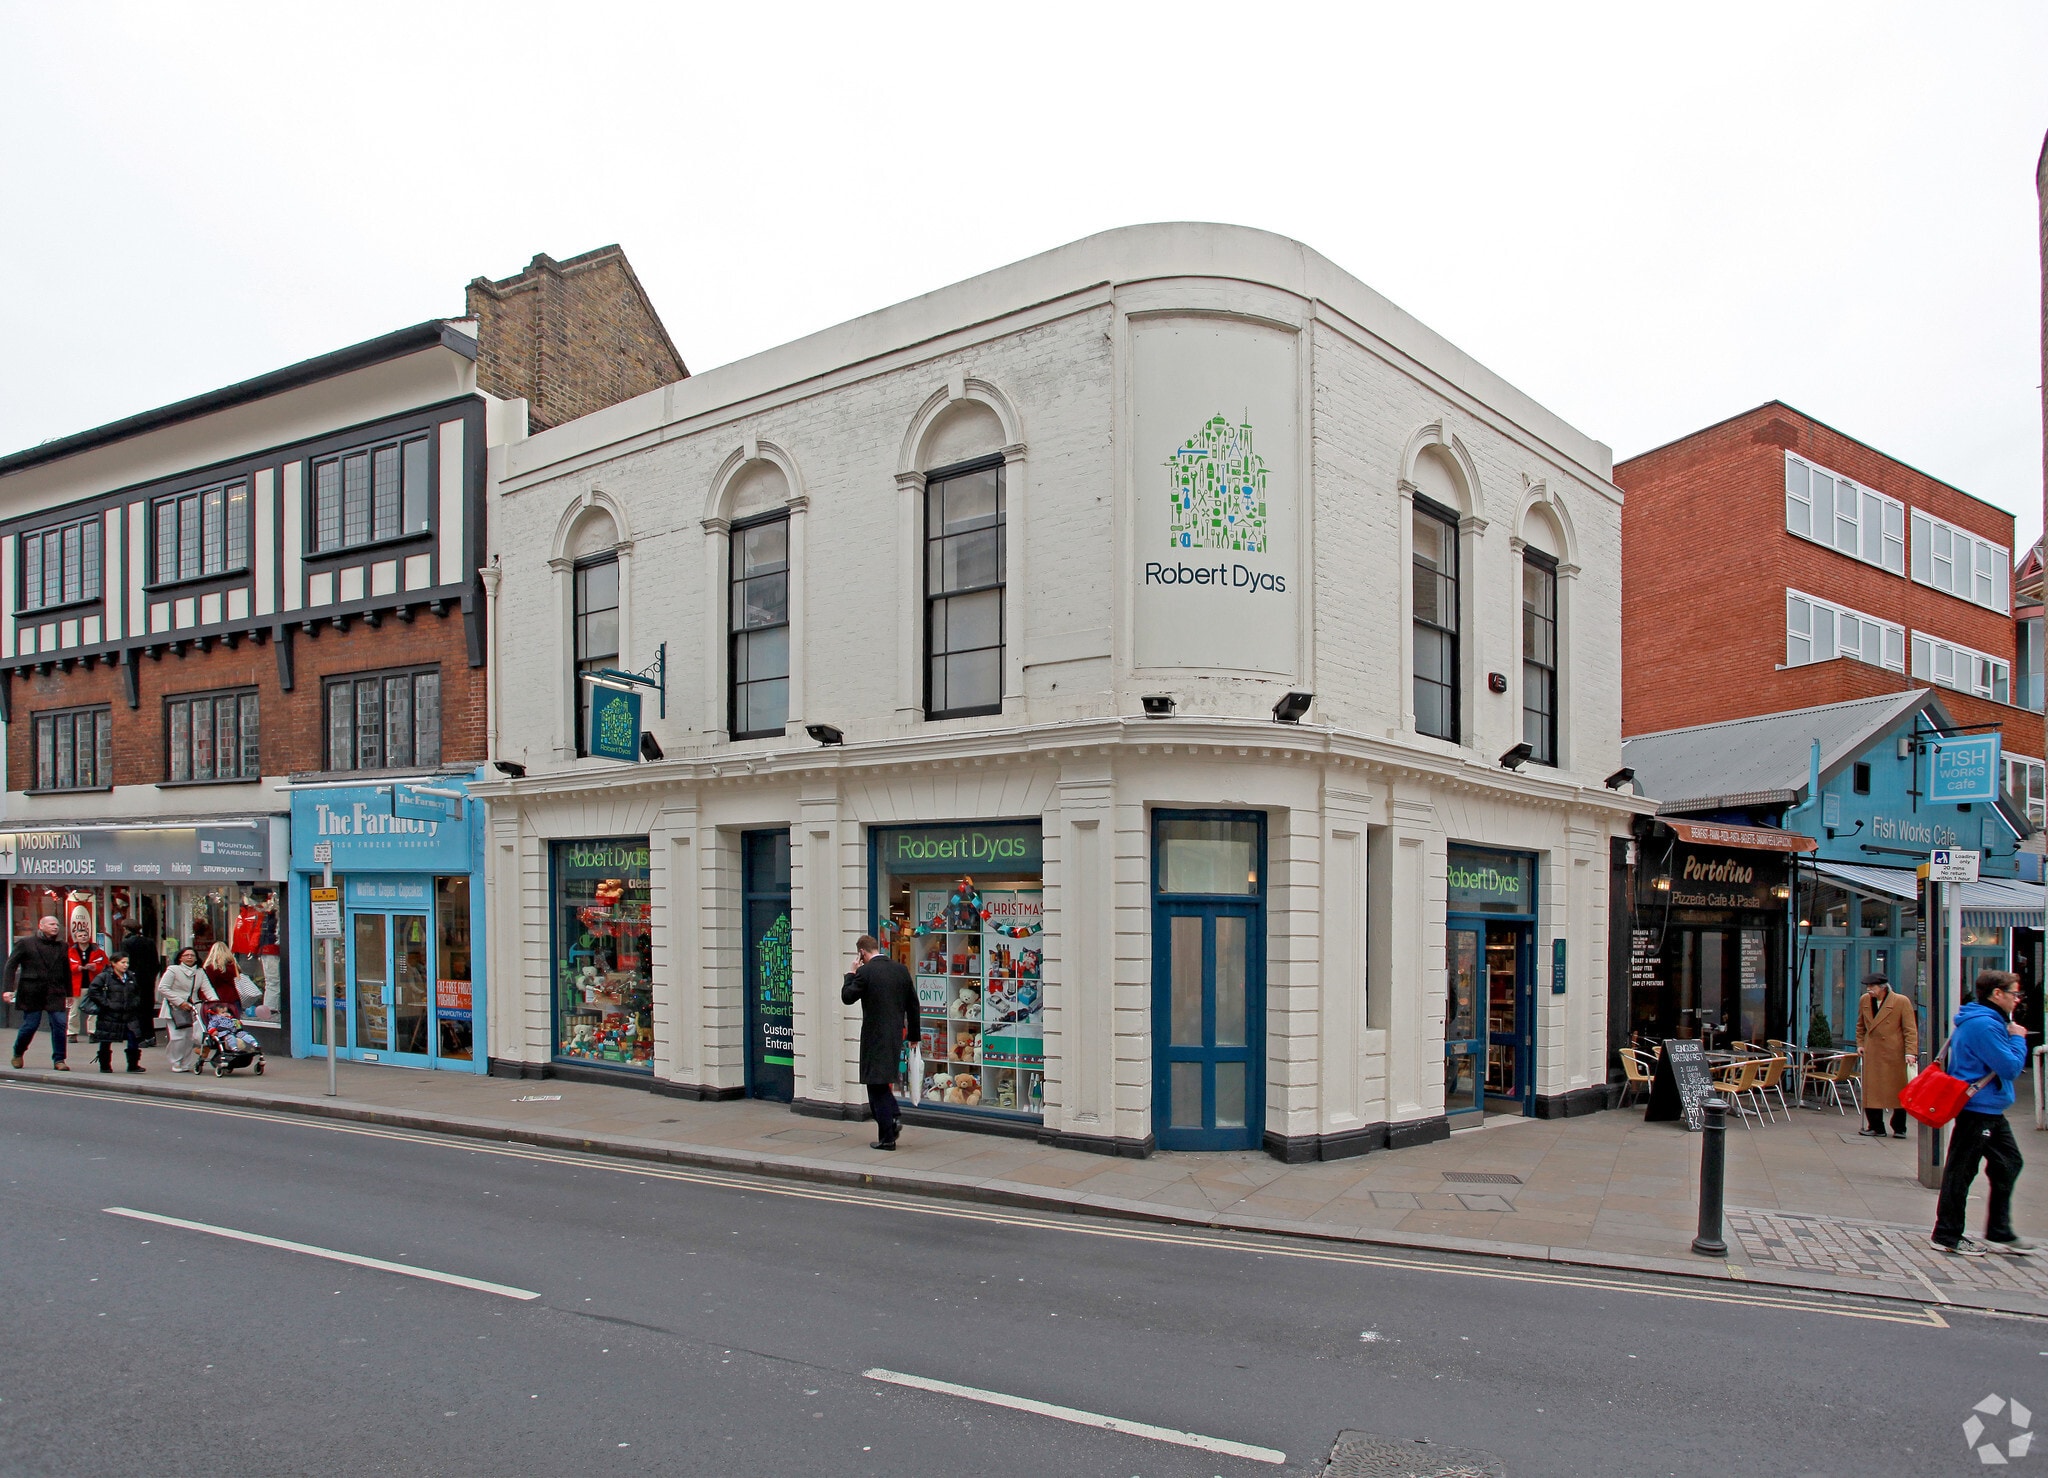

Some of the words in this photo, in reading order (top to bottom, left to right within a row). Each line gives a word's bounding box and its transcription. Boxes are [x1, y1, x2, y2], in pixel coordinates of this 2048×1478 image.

[1145, 562, 1228, 586] Robert
[1233, 564, 1287, 594] Dyas
[600, 743, 619, 753] Robert
[619, 747, 632, 756] Dyas
[1940, 749, 1986, 768] FISH
[1940, 768, 1985, 779] WORKS
[1947, 779, 1976, 791] cafe
[398, 794, 414, 804] The
[415, 796, 445, 810] Farmery
[316, 804, 351, 836] The
[1873, 816, 1896, 839] Fish
[1899, 820, 1931, 844] Works
[1933, 825, 1956, 846] Cafe
[20, 834, 81, 850] MOUNTAIN
[217, 841, 254, 849] MOUNTAIN
[898, 834, 968, 859] Robert
[971, 833, 1026, 863] Dyas
[217, 848, 262, 858] WAREHOUSE
[568, 848, 612, 868] Robert
[615, 847, 648, 870] Dyas
[22, 857, 96, 874] WAREHOUSE
[105, 863, 123, 872] travel
[133, 863, 161, 875] camping
[171, 863, 192, 874] hiking
[1683, 855, 1753, 884] Portofino
[1447, 865, 1488, 889] Robert
[1489, 869, 1519, 895] Dyas
[927, 903, 940, 911] GIFT
[1672, 891, 1706, 906] Pizzeria
[1707, 893, 1727, 906] Cafe
[1728, 895, 1736, 907] &
[1737, 895, 1760, 908] Pasta
[986, 901, 1043, 916] CHRISTMAS
[920, 991, 932, 1001] ON
[933, 991, 944, 1001] TV
[761, 1004, 787, 1016] Robert
[1675, 1044, 1700, 1052] ENGLISH
[1671, 1053, 1703, 1062] BREAKFAST
